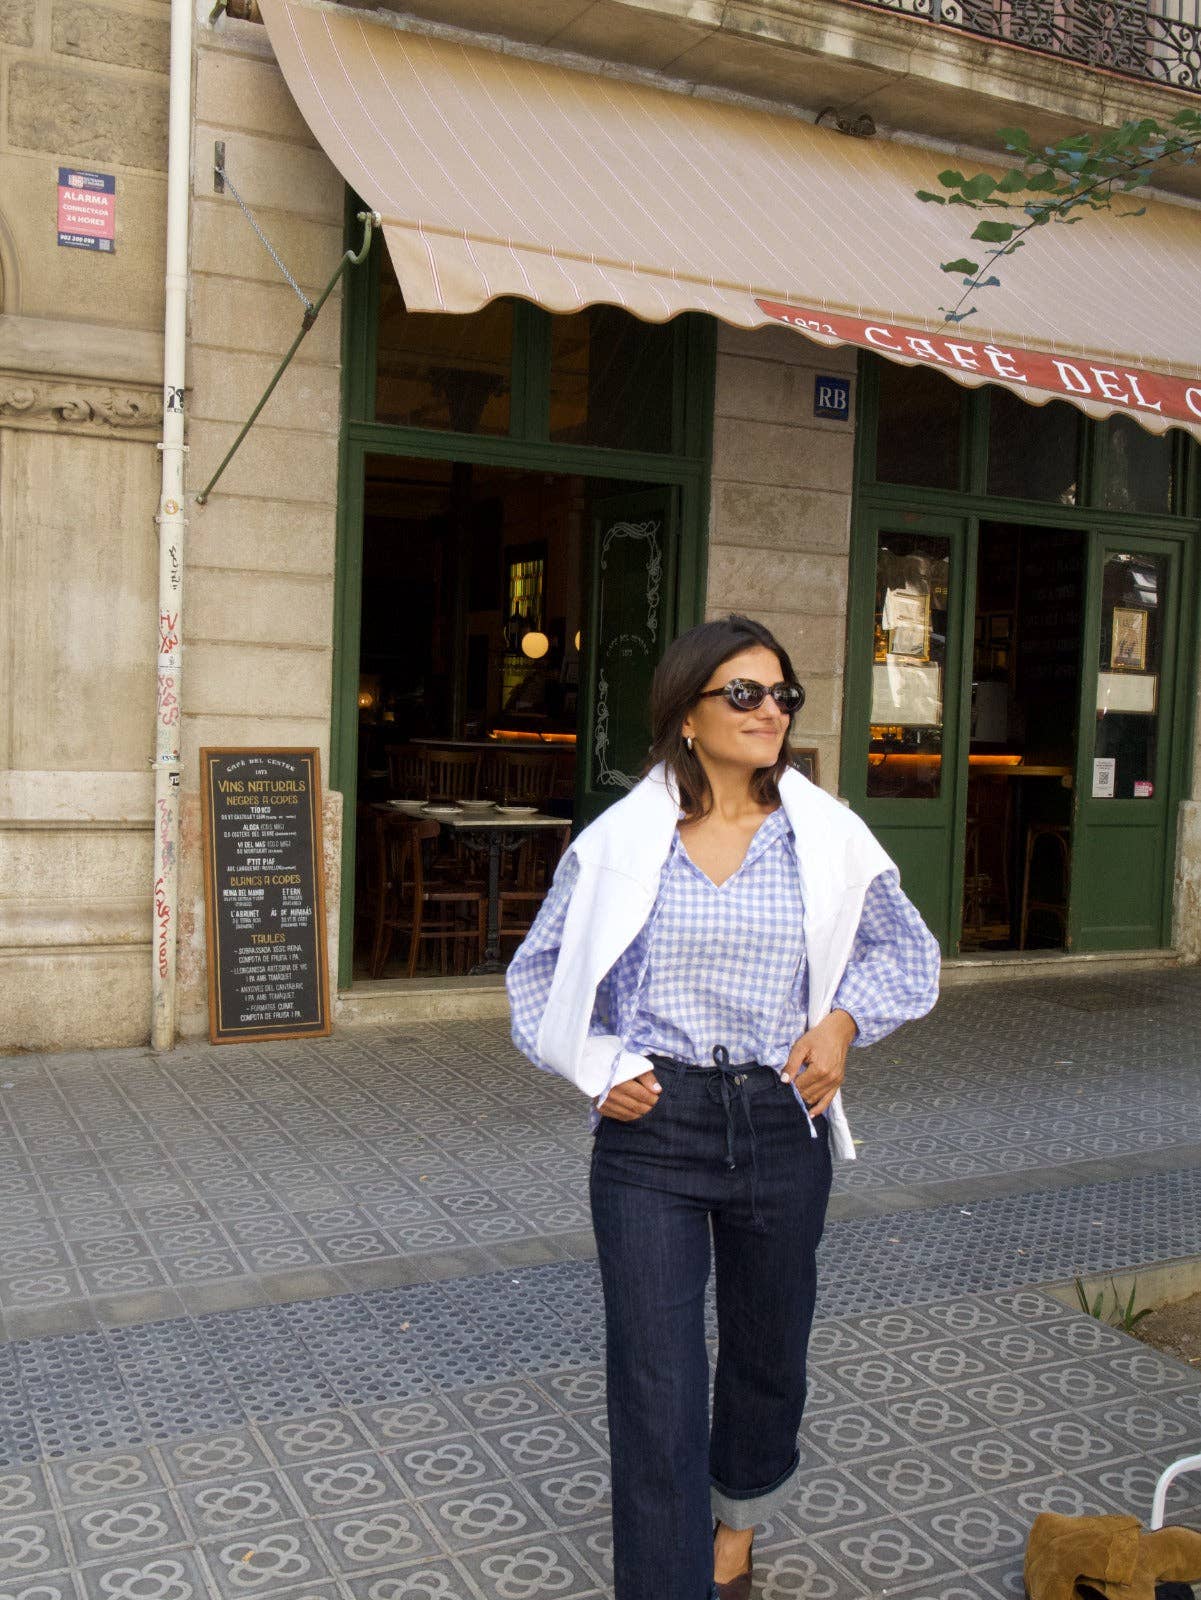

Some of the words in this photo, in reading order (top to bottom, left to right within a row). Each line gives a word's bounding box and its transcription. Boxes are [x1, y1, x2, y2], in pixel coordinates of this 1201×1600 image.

[63, 191, 108, 206] ALARMA
[77, 215, 105, 226] HORES
[864, 327, 1027, 383] CAFÈ
[1052, 360, 1161, 411] DEL
[818, 386, 847, 410] RB
[218, 780, 245, 793] VINS
[247, 780, 306, 792] NATURALS
[226, 795, 260, 806] NEGRES
[262, 795, 269, 805] A
[270, 795, 299, 805] COPES
[230, 876, 262, 887] BLANCS
[264, 875, 270, 886] A
[271, 874, 301, 885] COPES
[251, 933, 286, 944] TAULES
[249, 975, 256, 983] PA
[247, 994, 255, 1002] PA
[240, 1013, 264, 1022] COMPOTA
[264, 1012, 272, 1020] DE
